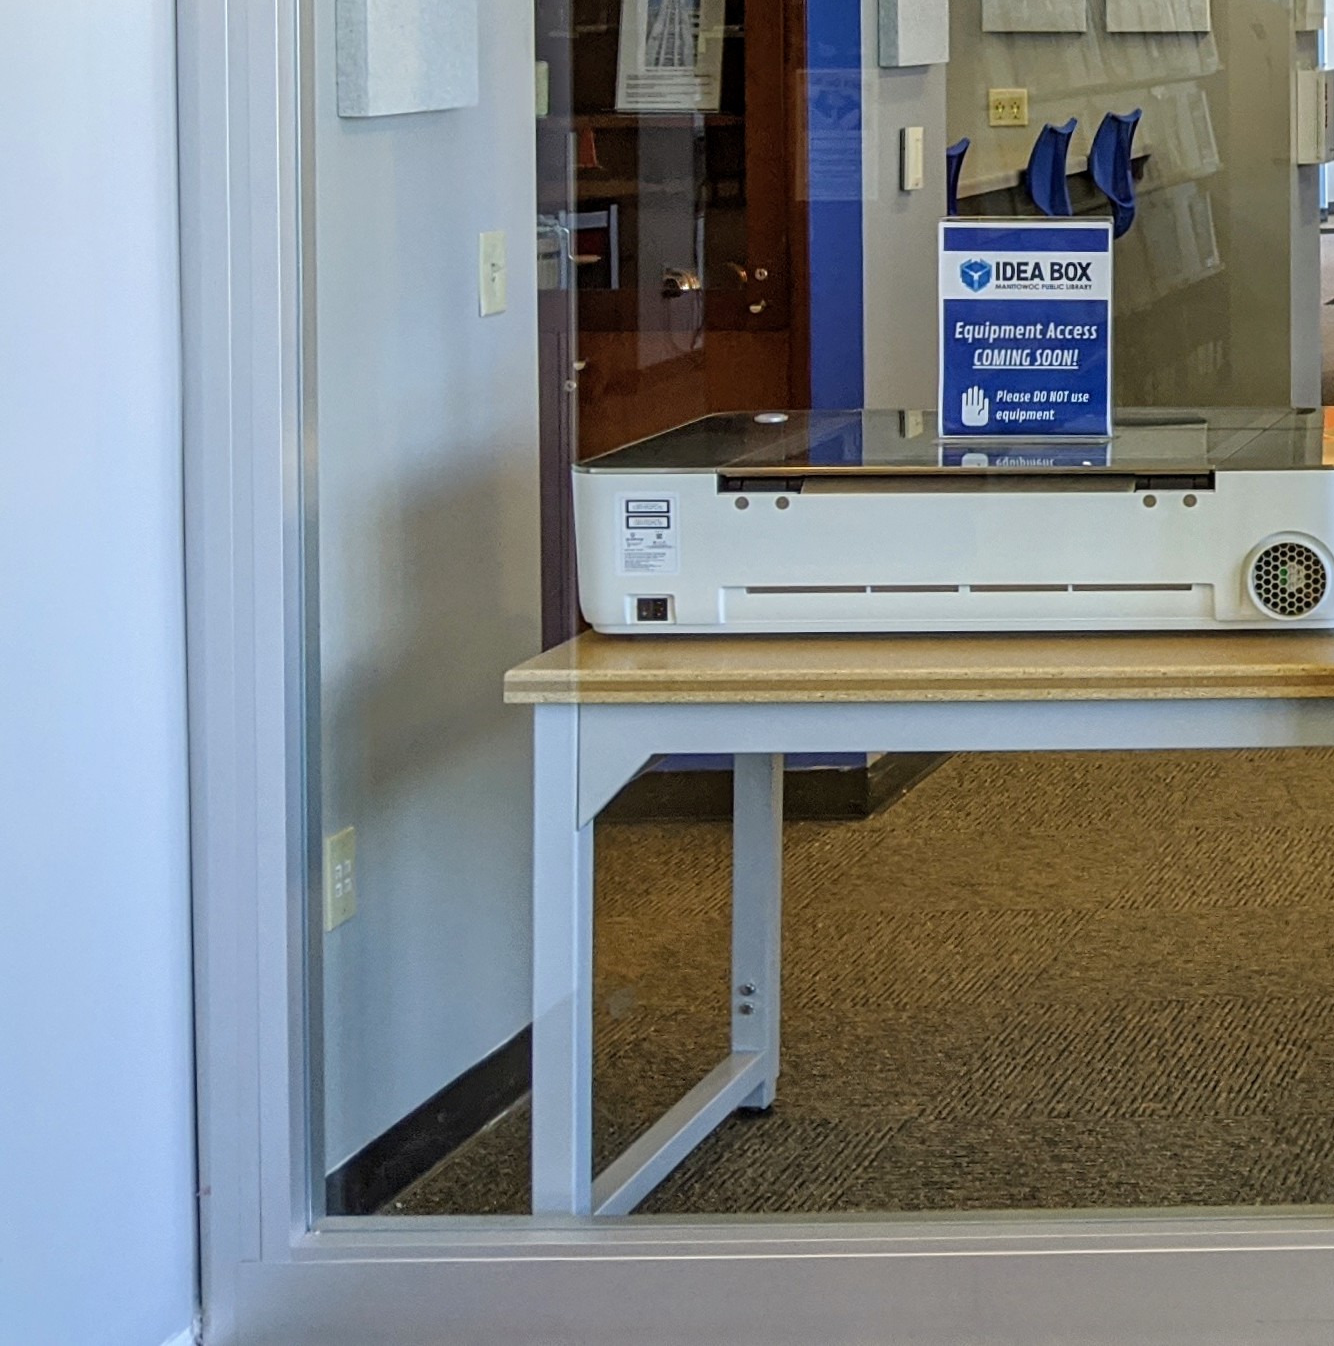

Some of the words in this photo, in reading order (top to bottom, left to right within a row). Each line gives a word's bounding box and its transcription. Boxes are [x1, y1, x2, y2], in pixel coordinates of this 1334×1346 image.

[995, 261, 1045, 282] IDEA
[1050, 261, 1092, 282] BOX
[1066, 283, 1092, 291] LIBRARY
[954, 321, 1043, 343] Equipment
[1046, 322, 1098, 339] Access
[973, 348, 1031, 367] COMING
[1034, 348, 1079, 367] SOON!
[996, 389, 1031, 403] Please
[1033, 390, 1047, 403] DO
[1049, 390, 1070, 403] NOT
[1071, 391, 1090, 403] use
[995, 408, 1055, 423] equipment
